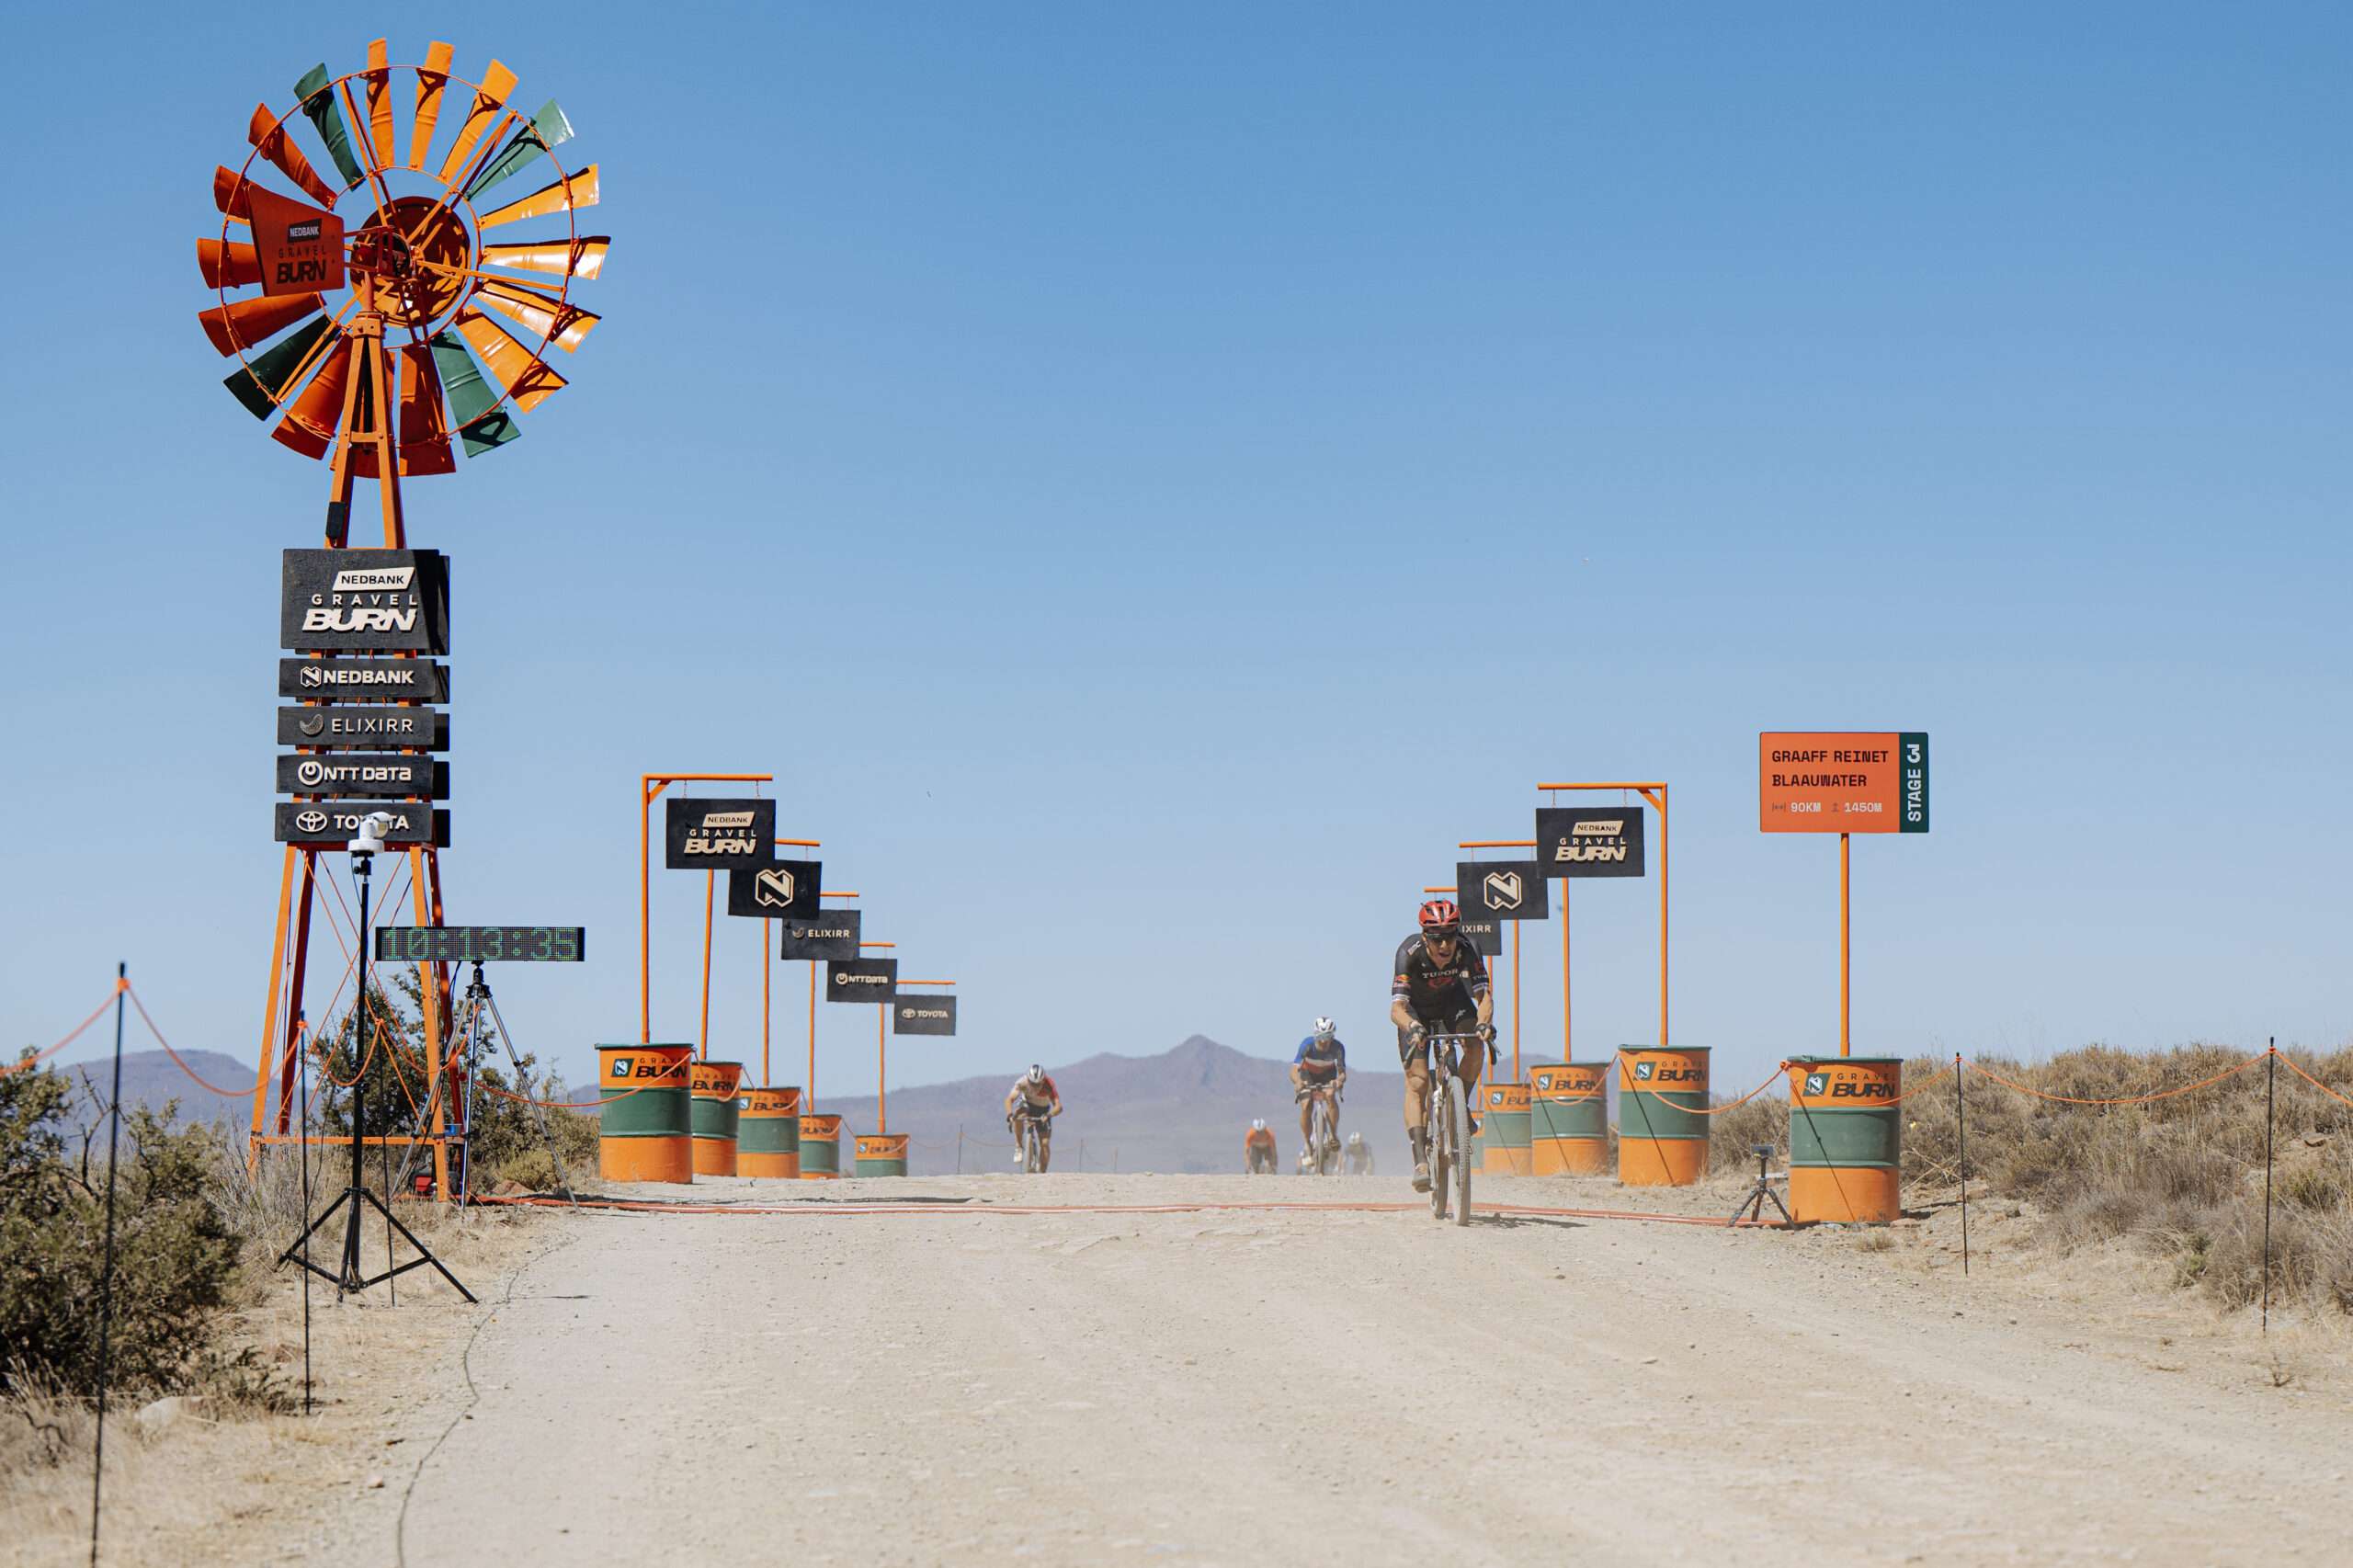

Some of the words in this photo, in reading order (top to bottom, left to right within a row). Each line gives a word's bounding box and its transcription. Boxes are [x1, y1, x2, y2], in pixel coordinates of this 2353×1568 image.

[290, 226, 320, 237] NEDBANK
[277, 260, 326, 284] BURN
[341, 574, 404, 585] NEDBANK
[312, 594, 418, 606] GRAVEL
[301, 608, 417, 631] BURN
[323, 670, 415, 685] NEDBANK
[331, 718, 414, 733] ELIXIRR
[1771, 750, 1828, 763] GRAAFF
[1834, 750, 1889, 763] REINET
[1907, 744, 1921, 763] 3
[1771, 774, 1868, 787] BLAAUWATER
[1907, 768, 1922, 822] STAGE
[1790, 801, 1822, 813] 90KM
[334, 814, 410, 829] TOTA
[689, 829, 756, 837] GRAVEL
[684, 838, 756, 854] BURN
[1559, 837, 1626, 846] GRAVEL
[1554, 846, 1627, 861] BURN
[808, 929, 850, 938] ELIXIRR
[1462, 925, 1492, 933] IXIRR
[384, 926, 577, 960] 10:13:35
[1832, 1083, 1895, 1097] BURN
